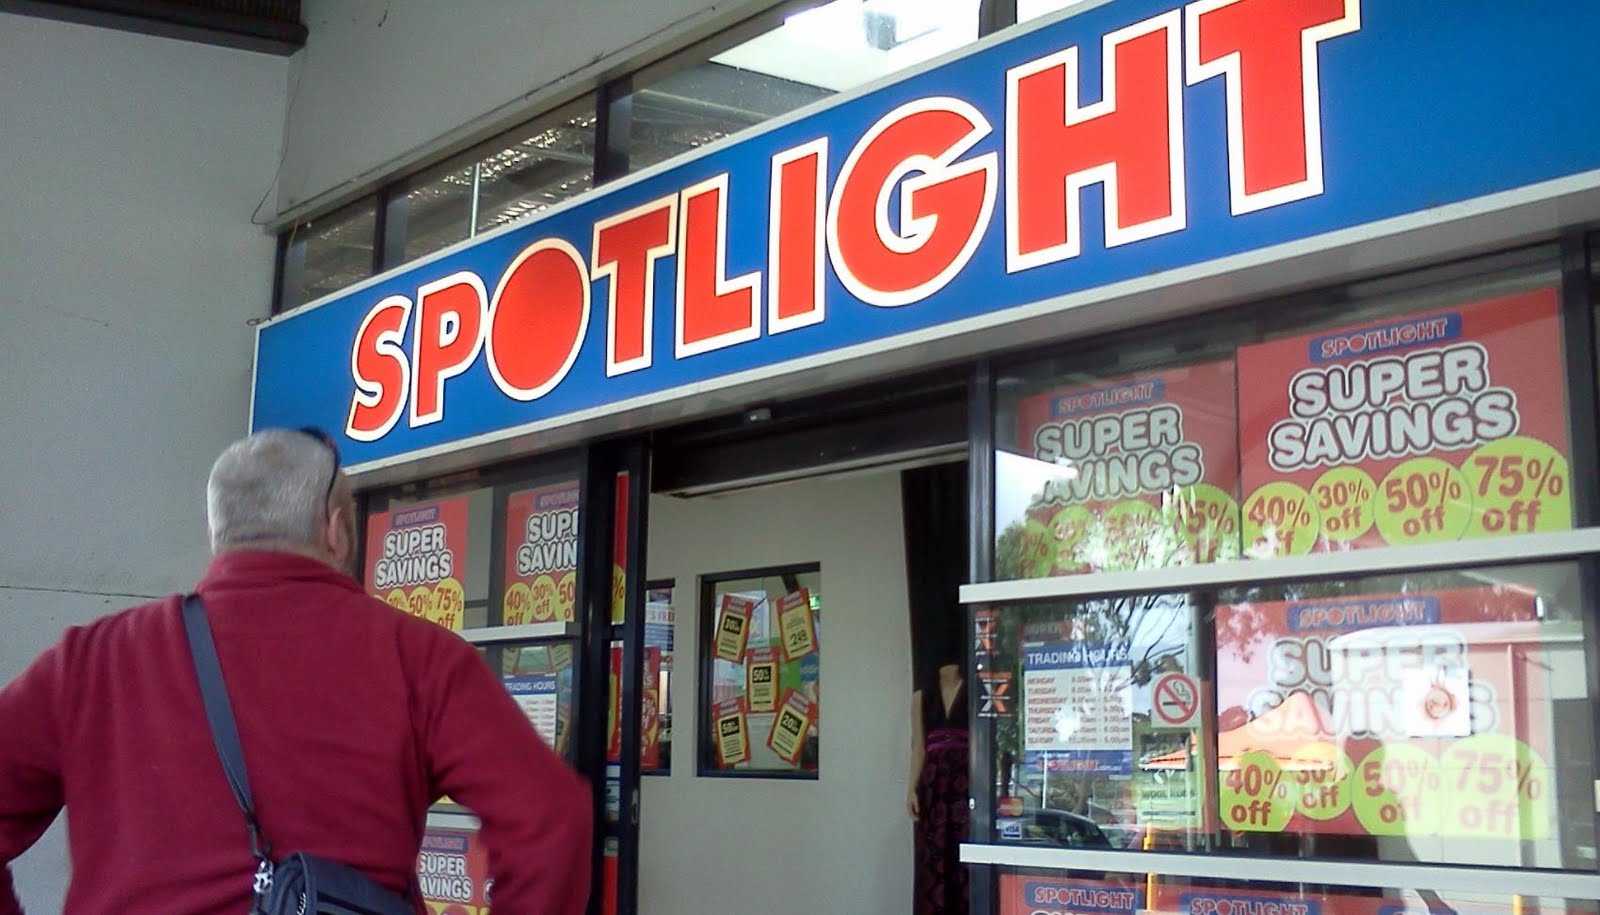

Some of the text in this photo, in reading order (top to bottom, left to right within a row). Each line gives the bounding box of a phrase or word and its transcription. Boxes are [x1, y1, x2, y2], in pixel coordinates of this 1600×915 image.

[345, 0, 1361, 442] SPOTLIGHT
[1321, 317, 1449, 359] SPOTLIGHT
[1057, 382, 1155, 414] SPOTLIGHT
[1290, 344, 1488, 418] SUPER
[1036, 406, 1181, 462] SUPER
[1269, 388, 1519, 471] SAVINGS
[1041, 445, 1203, 506] AVINGS
[1248, 456, 1563, 528] 40% 30% 50% 75%
[528, 511, 578, 544] SUP
[1325, 507, 1362, 532] off
[1402, 506, 1446, 537] off
[1481, 501, 1542, 533] off
[385, 524, 446, 558] SUPER
[518, 540, 578, 575] SAVIN
[376, 550, 452, 588] SAVINGS
[437, 587, 462, 612] 75%
[507, 590, 530, 612] 40%
[559, 582, 574, 602] 50
[508, 612, 523, 626] off
[535, 600, 551, 615] off
[1299, 602, 1426, 628] SPOTLIGHT
[1027, 651, 1081, 665] TRADING
[1268, 635, 1467, 688] SUPER
[1248, 681, 1497, 739] SAVINS
[1225, 770, 1287, 800] 40%
[1363, 759, 1441, 798] 50%
[1456, 751, 1541, 801] 75%
[1231, 786, 1518, 834] off off off off
[419, 854, 466, 877] SUPER
[420, 876, 472, 902] AVINGS
[1034, 886, 1134, 909] SPOTLIGHT
[1191, 898, 1309, 915] SPOTLIGHT
